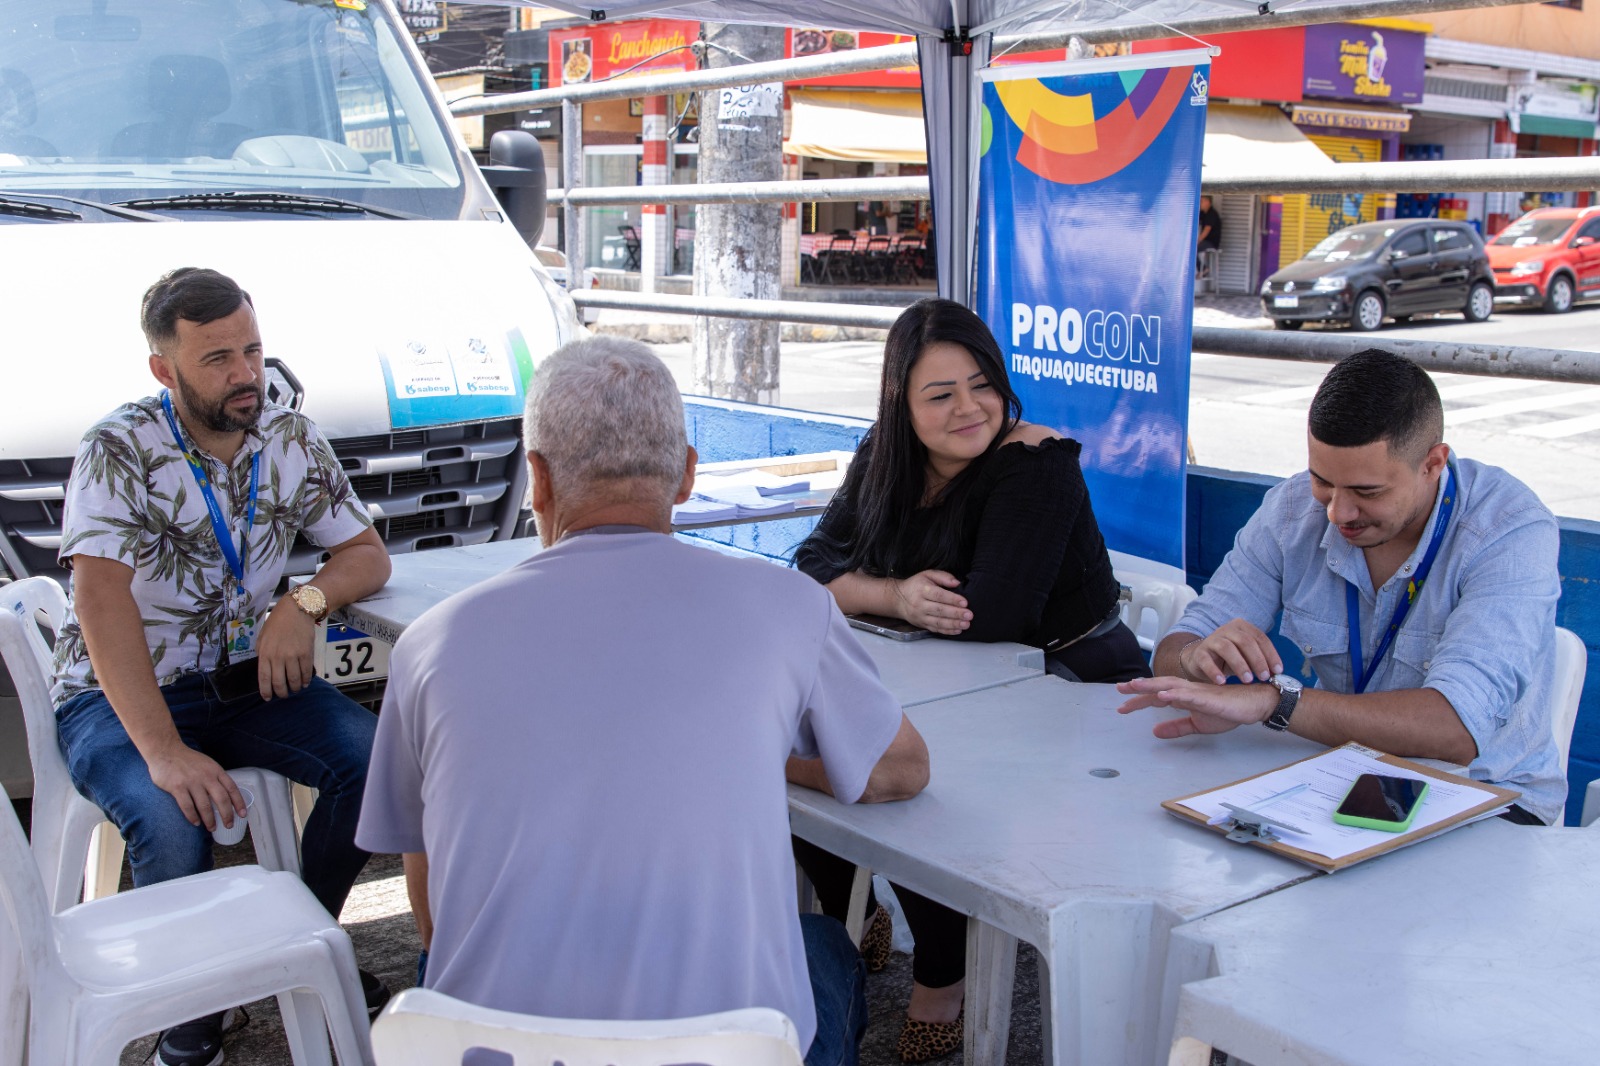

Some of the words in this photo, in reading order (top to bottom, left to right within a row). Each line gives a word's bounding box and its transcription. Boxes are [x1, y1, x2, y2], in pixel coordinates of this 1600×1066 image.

[1011, 302, 1161, 366] PROCON
[417, 385, 450, 393] sabesp
[478, 384, 510, 392] sabesp
[1011, 353, 1158, 394] ITAQUAQUECETUBA
[325, 641, 375, 678] 32
